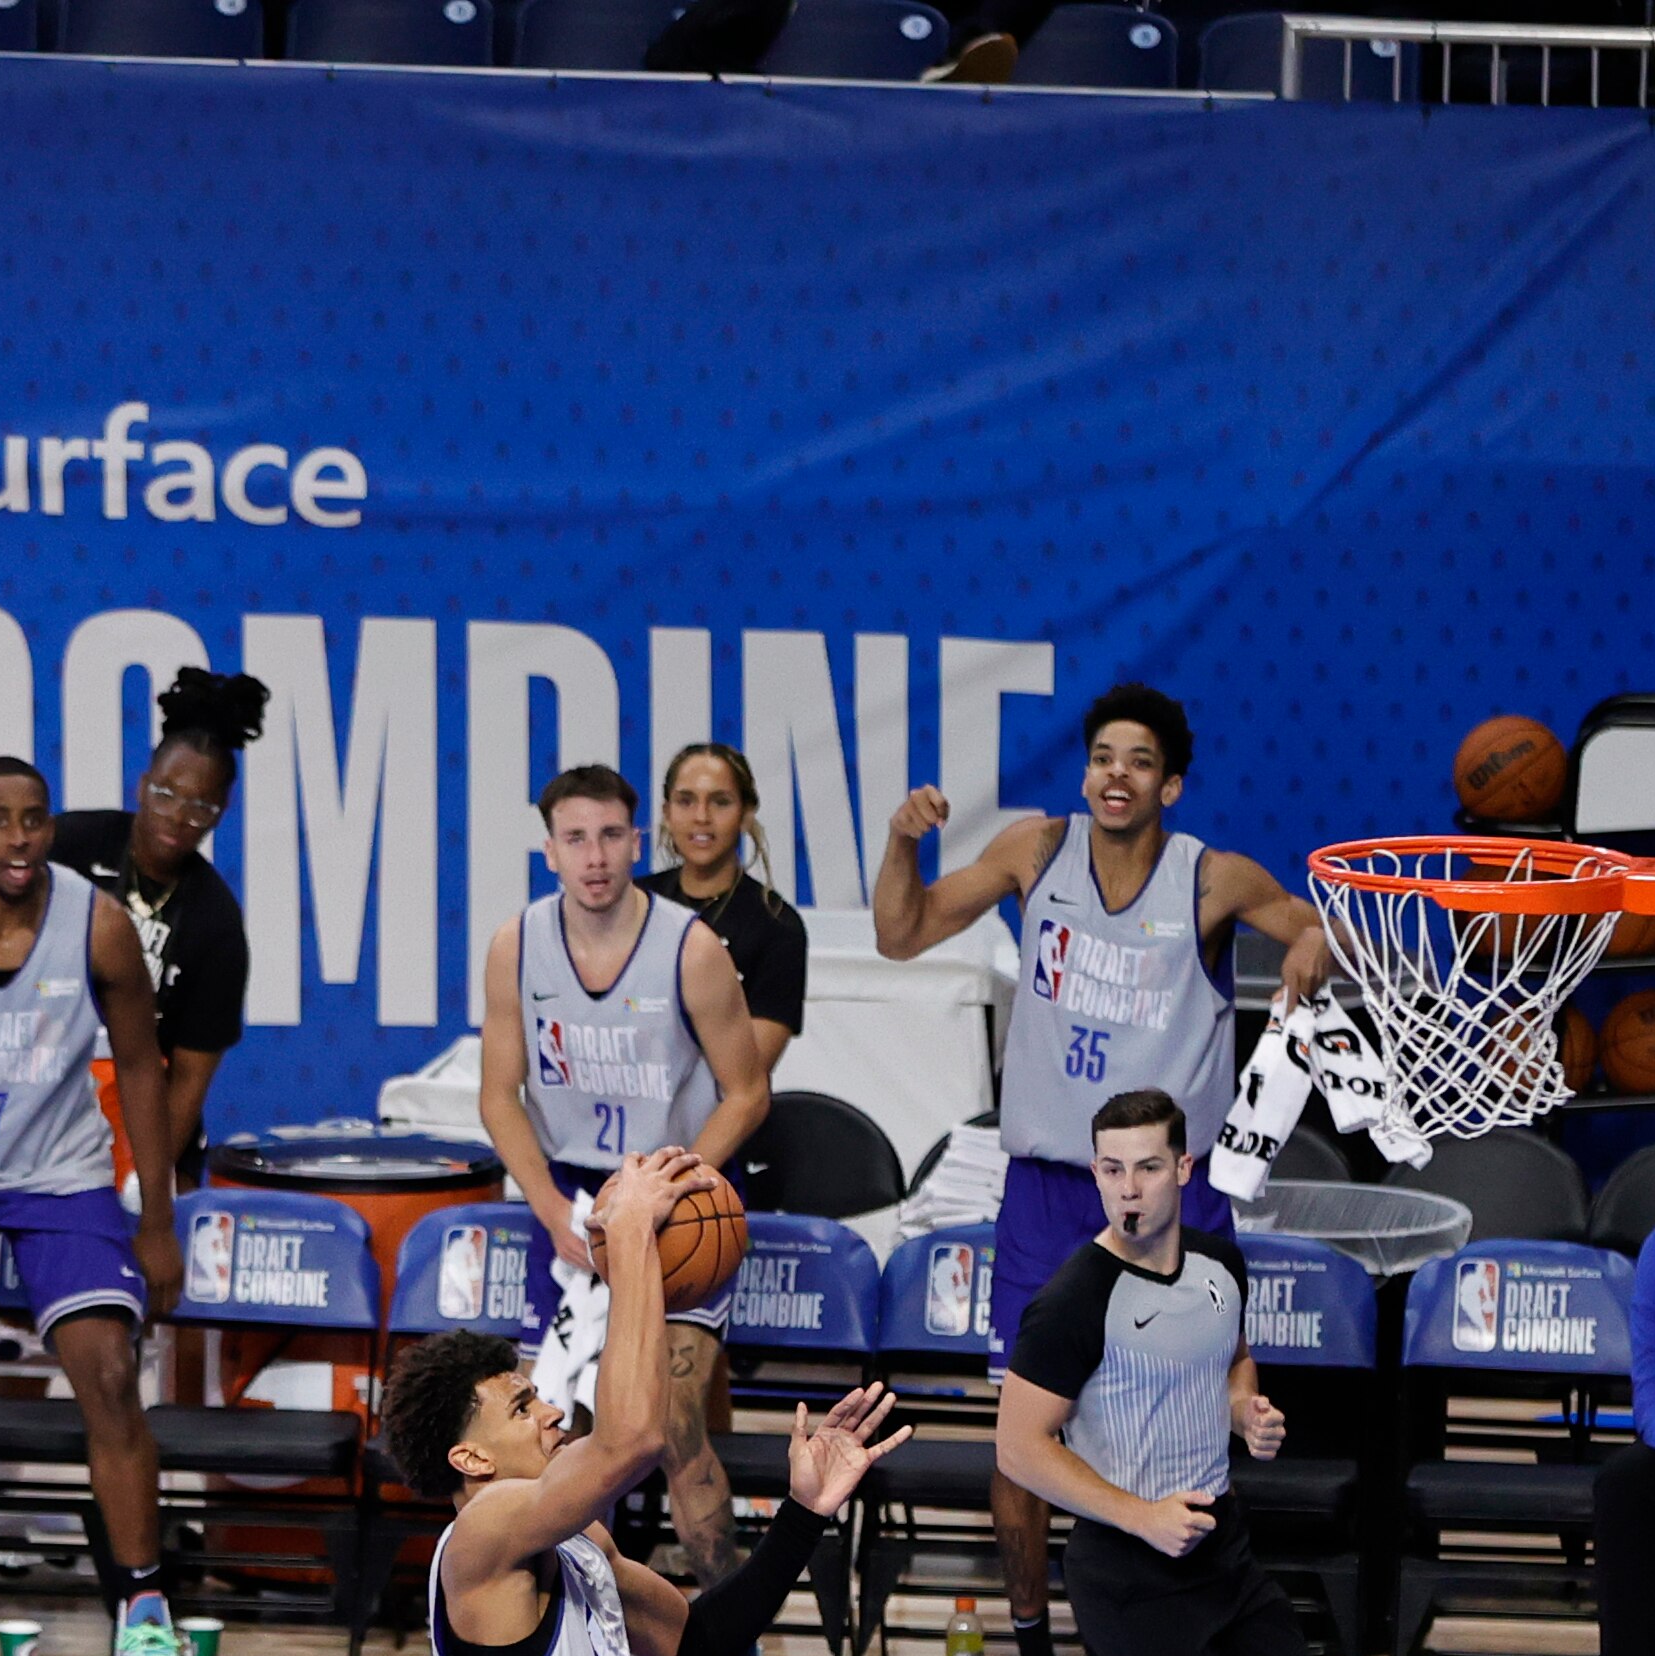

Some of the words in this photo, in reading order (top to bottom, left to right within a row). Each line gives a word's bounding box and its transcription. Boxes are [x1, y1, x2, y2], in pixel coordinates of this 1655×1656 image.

[1072, 932, 1147, 987] DRAFT
[1066, 971, 1173, 1032] COMBINE
[568, 1022, 638, 1064] DRAFT
[1065, 1024, 1111, 1083] 35
[573, 1058, 673, 1102] COMBINE
[594, 1103, 627, 1155] 21
[237, 1233, 305, 1271] DRAFT
[487, 1247, 528, 1285] DRA
[234, 1269, 330, 1308] COMBINE
[1246, 1275, 1297, 1314] RAFT
[1504, 1280, 1572, 1318] DRAFT
[731, 1291, 824, 1330] COMBINE
[1245, 1311, 1323, 1348] OMBINE
[1501, 1315, 1598, 1356] COMBINE
